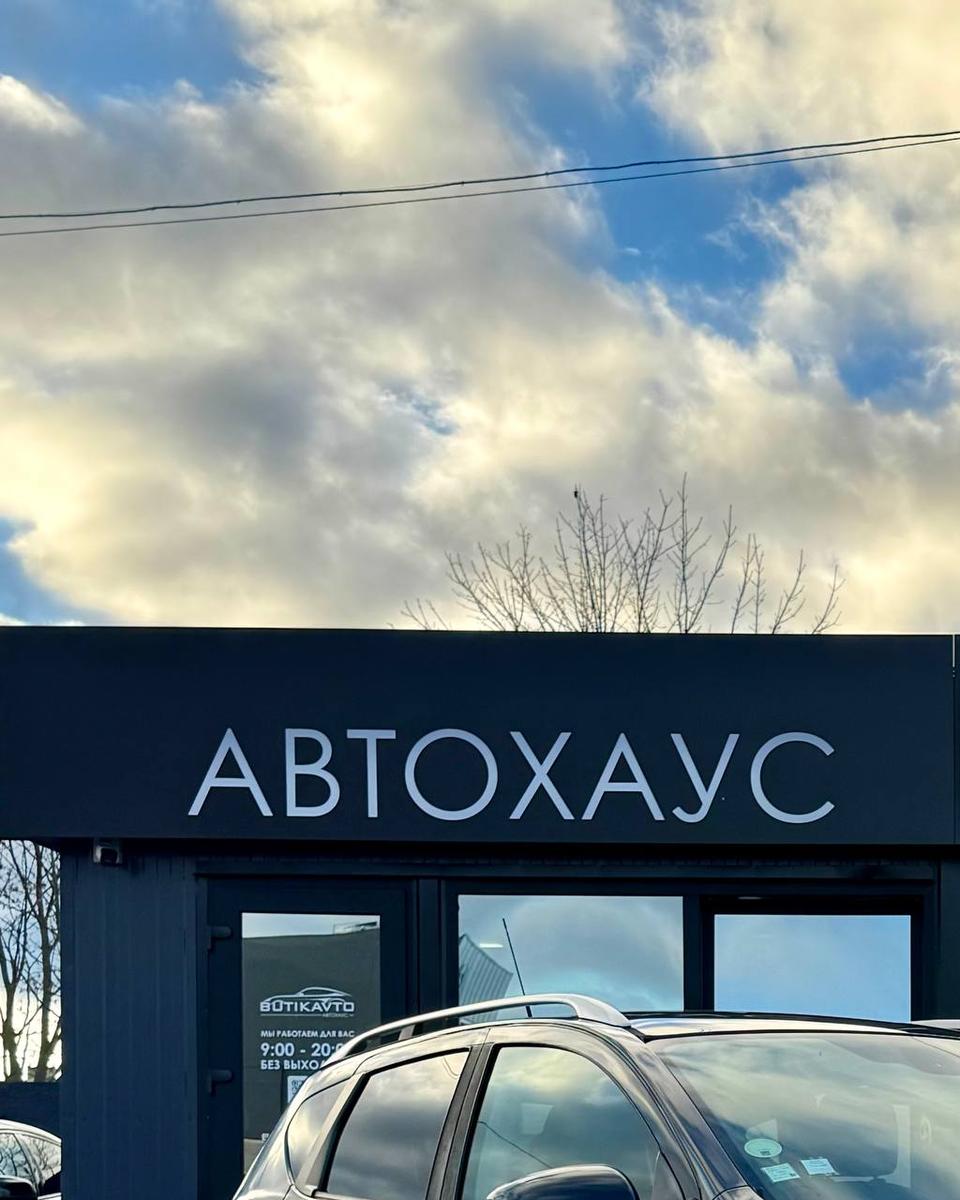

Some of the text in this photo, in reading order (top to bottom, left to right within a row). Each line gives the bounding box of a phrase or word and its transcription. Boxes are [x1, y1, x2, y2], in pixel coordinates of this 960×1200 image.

[187, 727, 835, 823] АВТОХАУС
[260, 1001, 355, 1012] BUTIKAVTO
[320, 1030, 336, 1038] ДЛЯ
[261, 1042, 295, 1057] 9:00
[311, 1043, 344, 1057] 20:
[260, 1060, 280, 1070] БЕЗ
